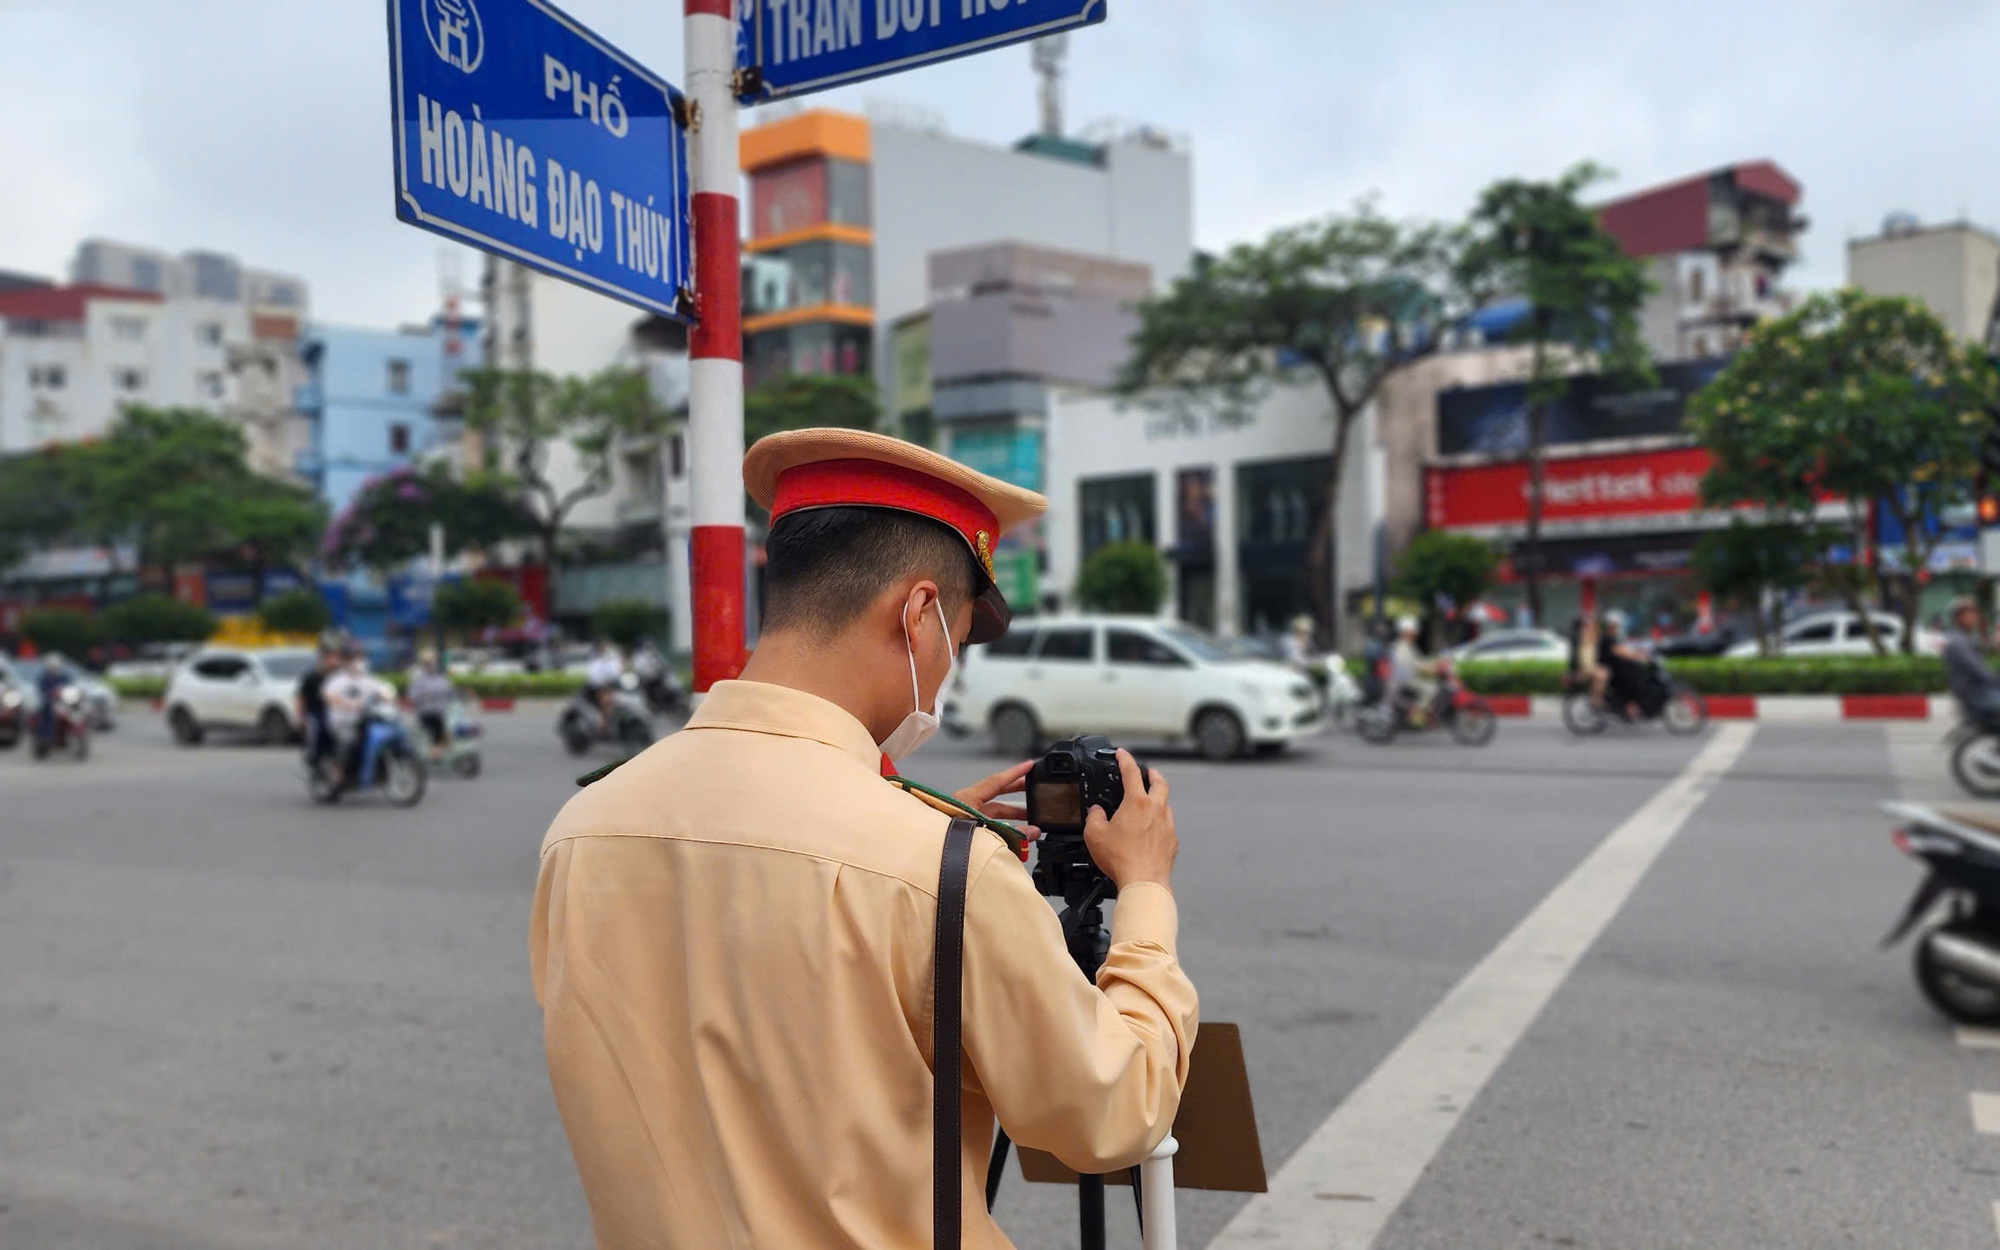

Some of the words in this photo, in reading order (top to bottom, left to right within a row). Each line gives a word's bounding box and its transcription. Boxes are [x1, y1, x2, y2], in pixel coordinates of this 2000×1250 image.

[544, 54, 629, 138] PHỐ
[418, 93, 538, 229] HOÀNG
[547, 158, 604, 262] ĐẠO
[610, 191, 671, 283] THÚY
